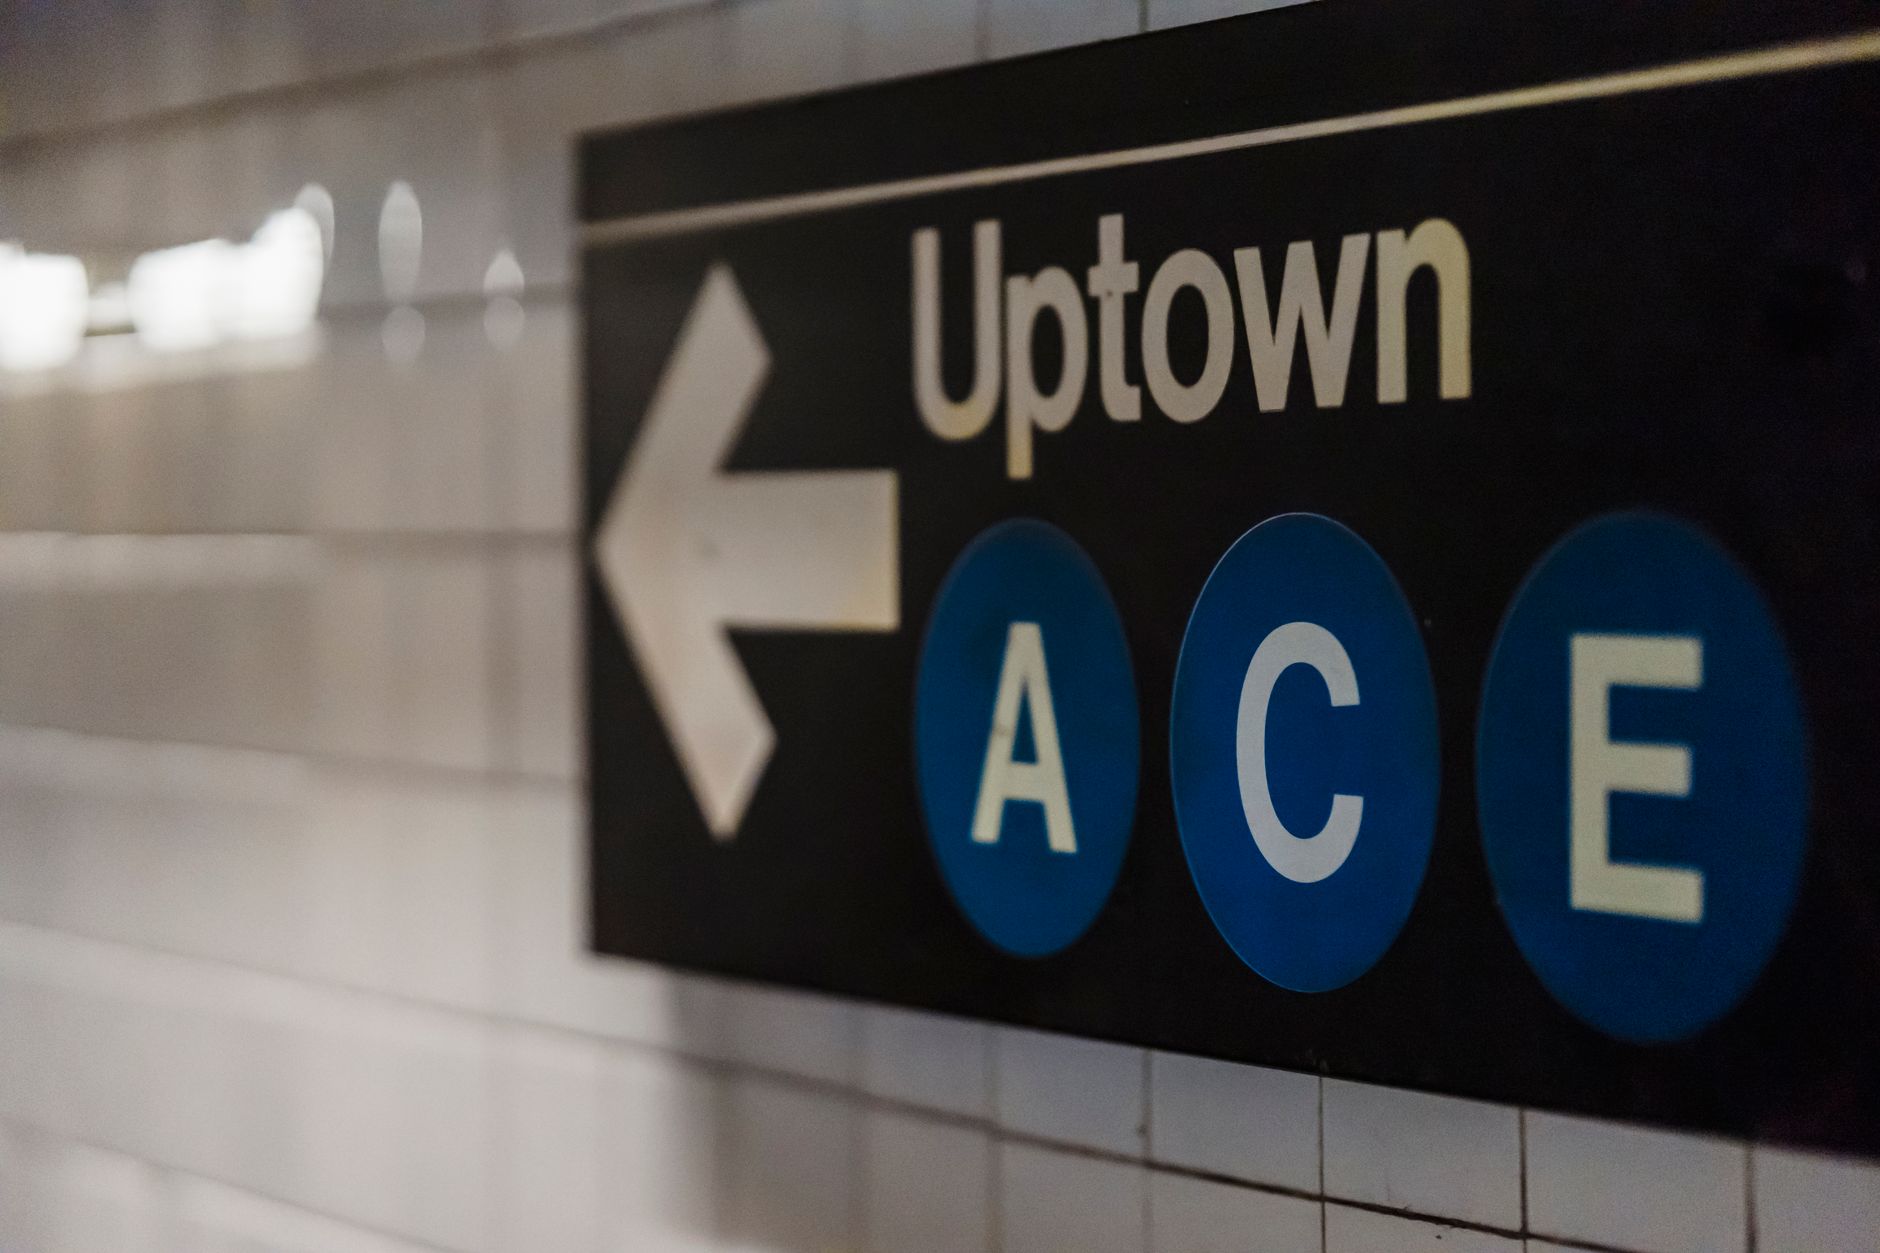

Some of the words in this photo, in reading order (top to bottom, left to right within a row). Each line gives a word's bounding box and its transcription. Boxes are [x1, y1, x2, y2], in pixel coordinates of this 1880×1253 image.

[911, 213, 1472, 480] Uptown
[969, 621, 1079, 854] A
[1235, 620, 1364, 884] C
[1570, 633, 1704, 923] E
